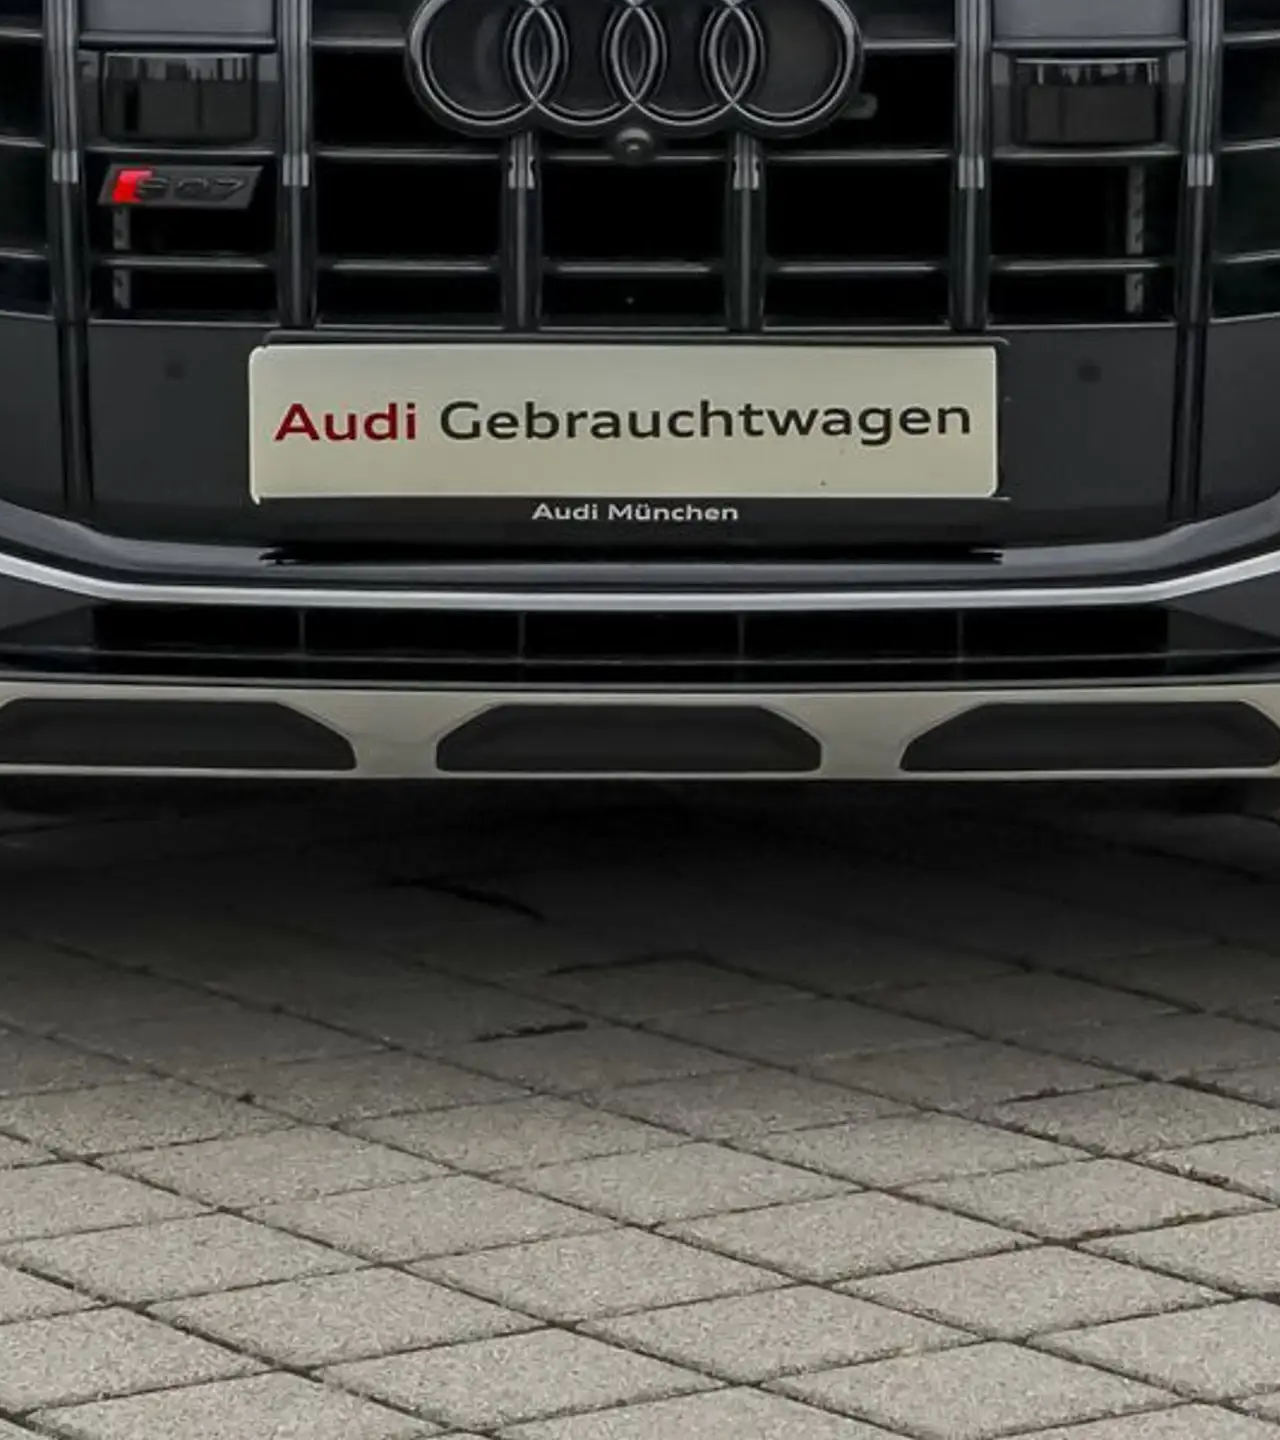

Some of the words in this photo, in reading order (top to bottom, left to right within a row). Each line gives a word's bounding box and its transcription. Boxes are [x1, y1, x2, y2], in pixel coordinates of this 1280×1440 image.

[274, 401, 417, 442] Audi
[439, 399, 972, 448] Gebrauchtwagen
[531, 501, 599, 522] Audi
[607, 501, 740, 522] München
